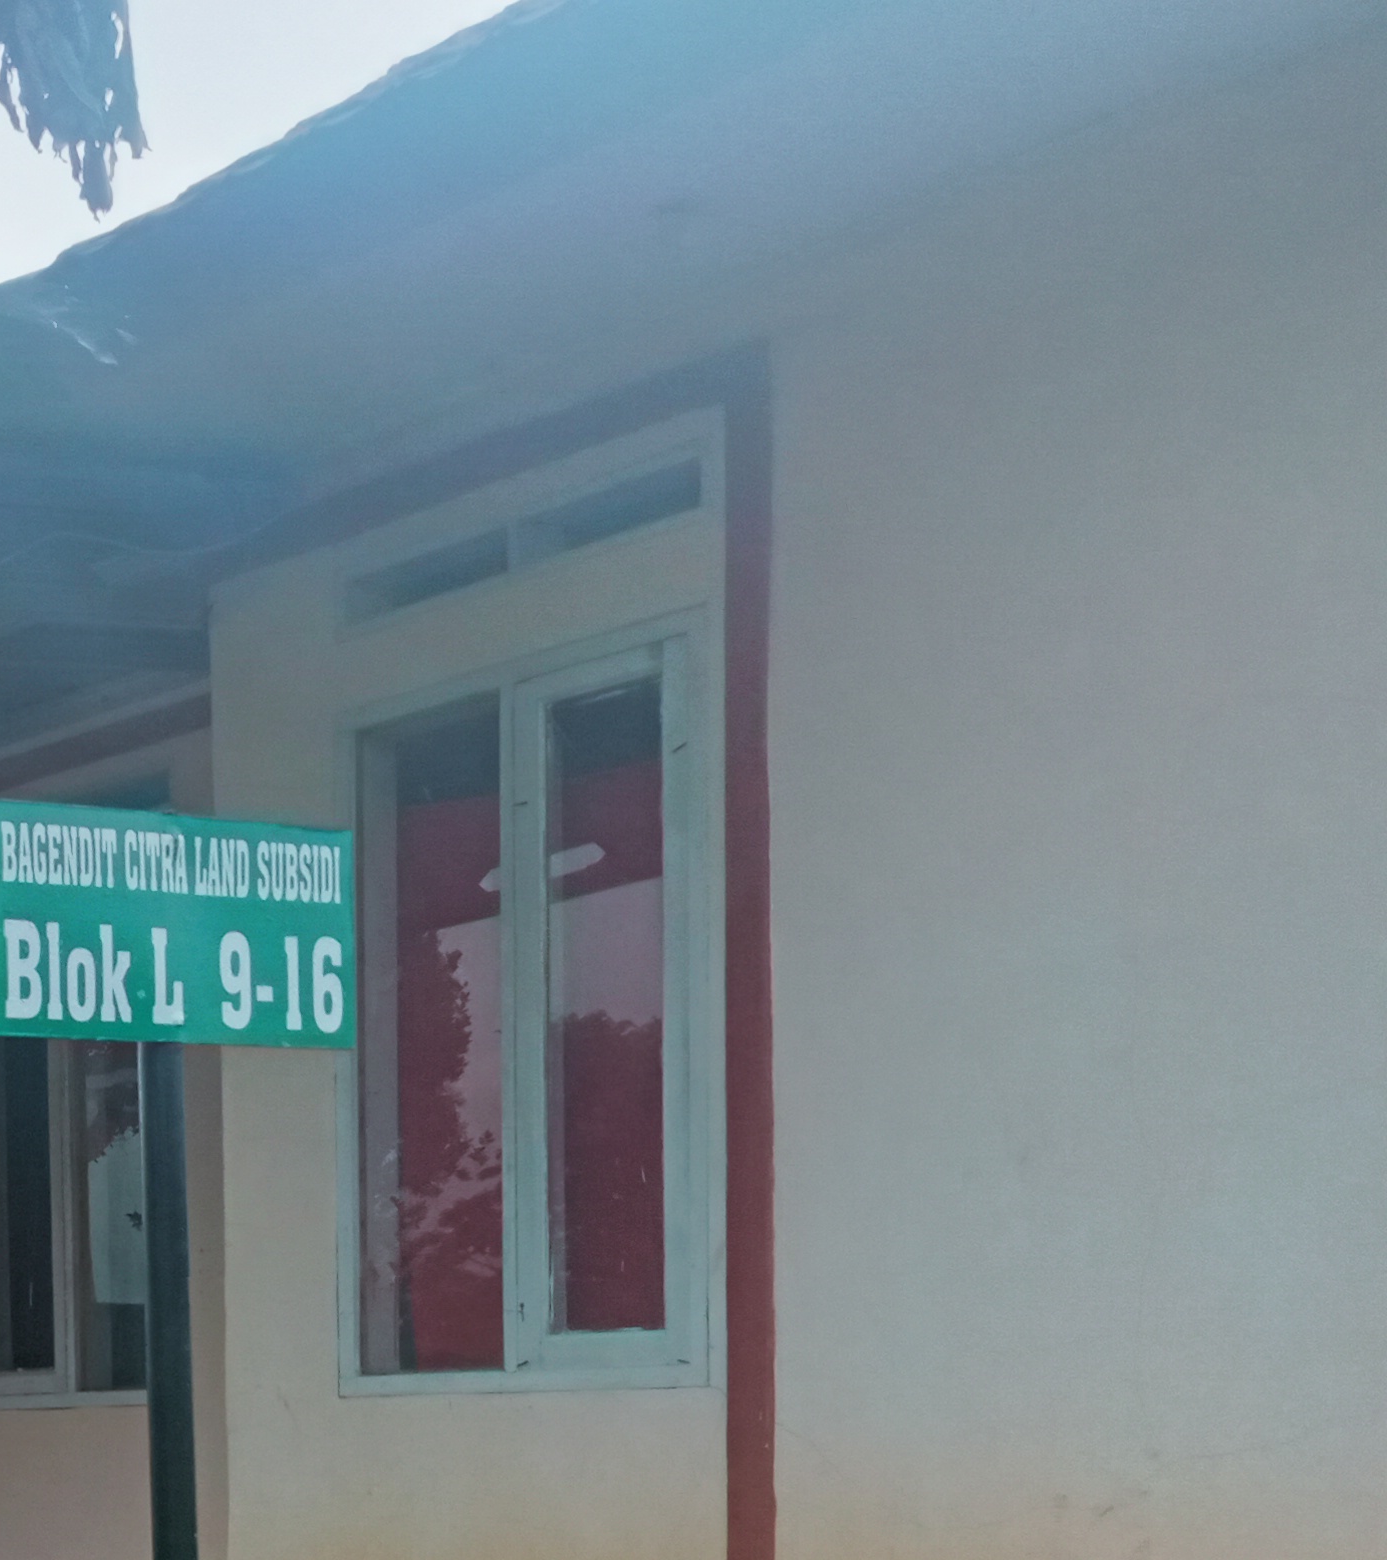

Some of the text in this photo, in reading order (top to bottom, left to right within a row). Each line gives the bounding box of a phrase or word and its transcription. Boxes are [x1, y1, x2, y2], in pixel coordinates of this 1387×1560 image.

[1, 821, 341, 904] BAGENDIT CITRA LAND SUBSIDI
[3, 919, 343, 1033] Blok L 9-16
